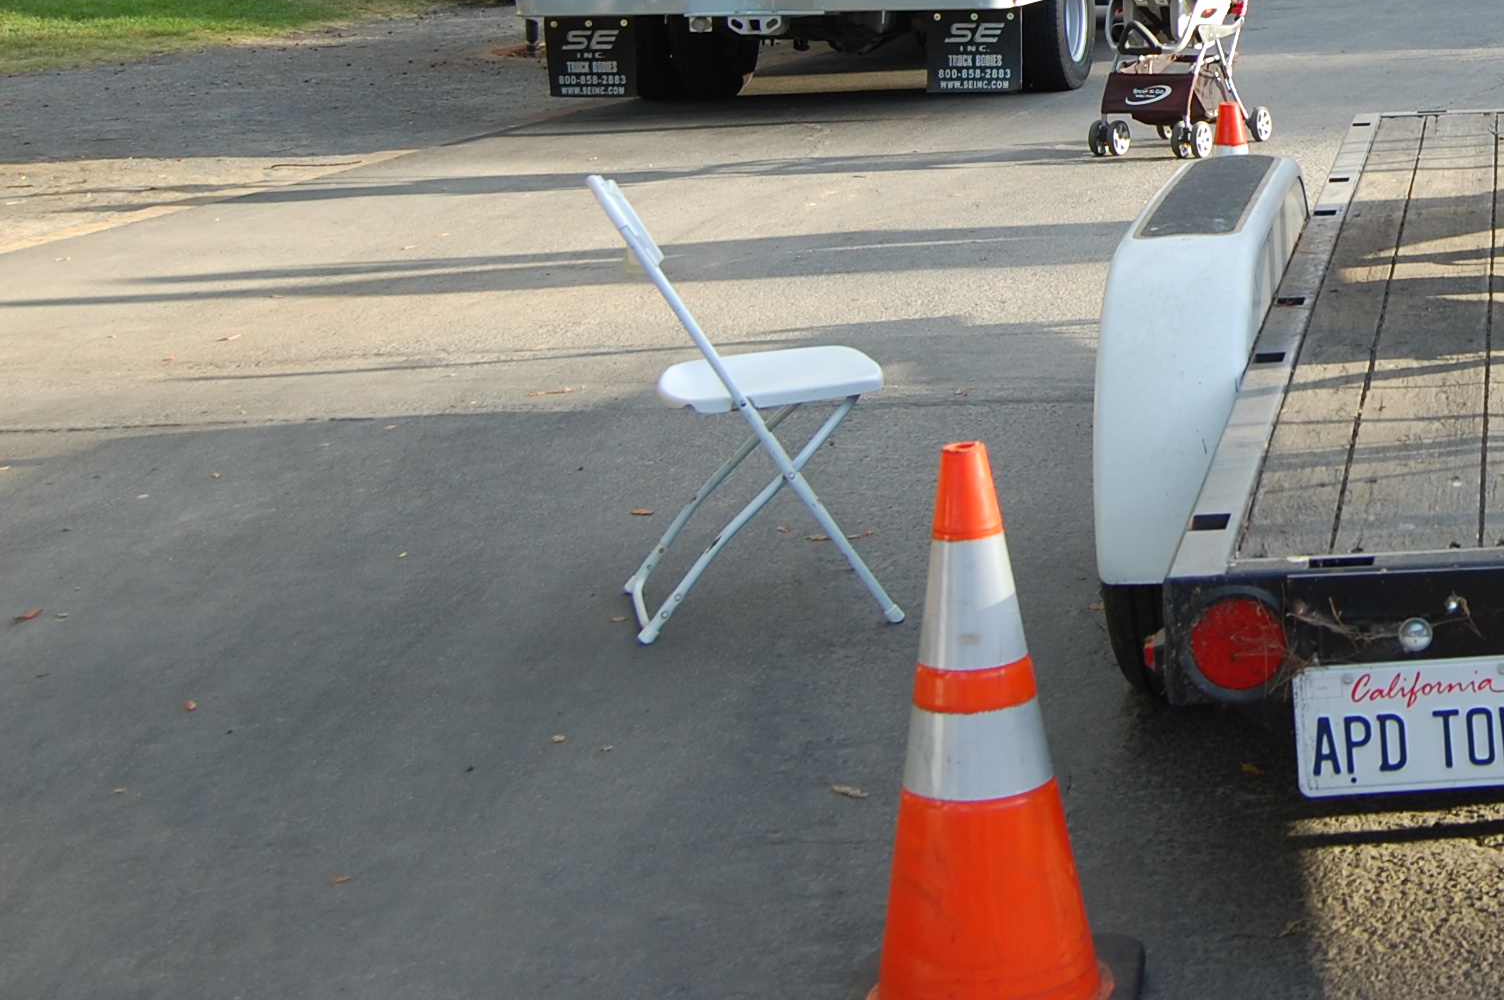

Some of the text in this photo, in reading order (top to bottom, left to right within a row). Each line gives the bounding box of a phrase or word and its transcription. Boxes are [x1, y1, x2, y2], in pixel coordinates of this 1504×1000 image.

[561, 29, 620, 50] SE
[944, 22, 1005, 43] SE
[948, 54, 1003, 67] TRUCK BODIES
[558, 75, 627, 85] 800-858-2883
[938, 69, 1012, 79] 800-858-2883
[1313, 713, 1408, 776] APD
